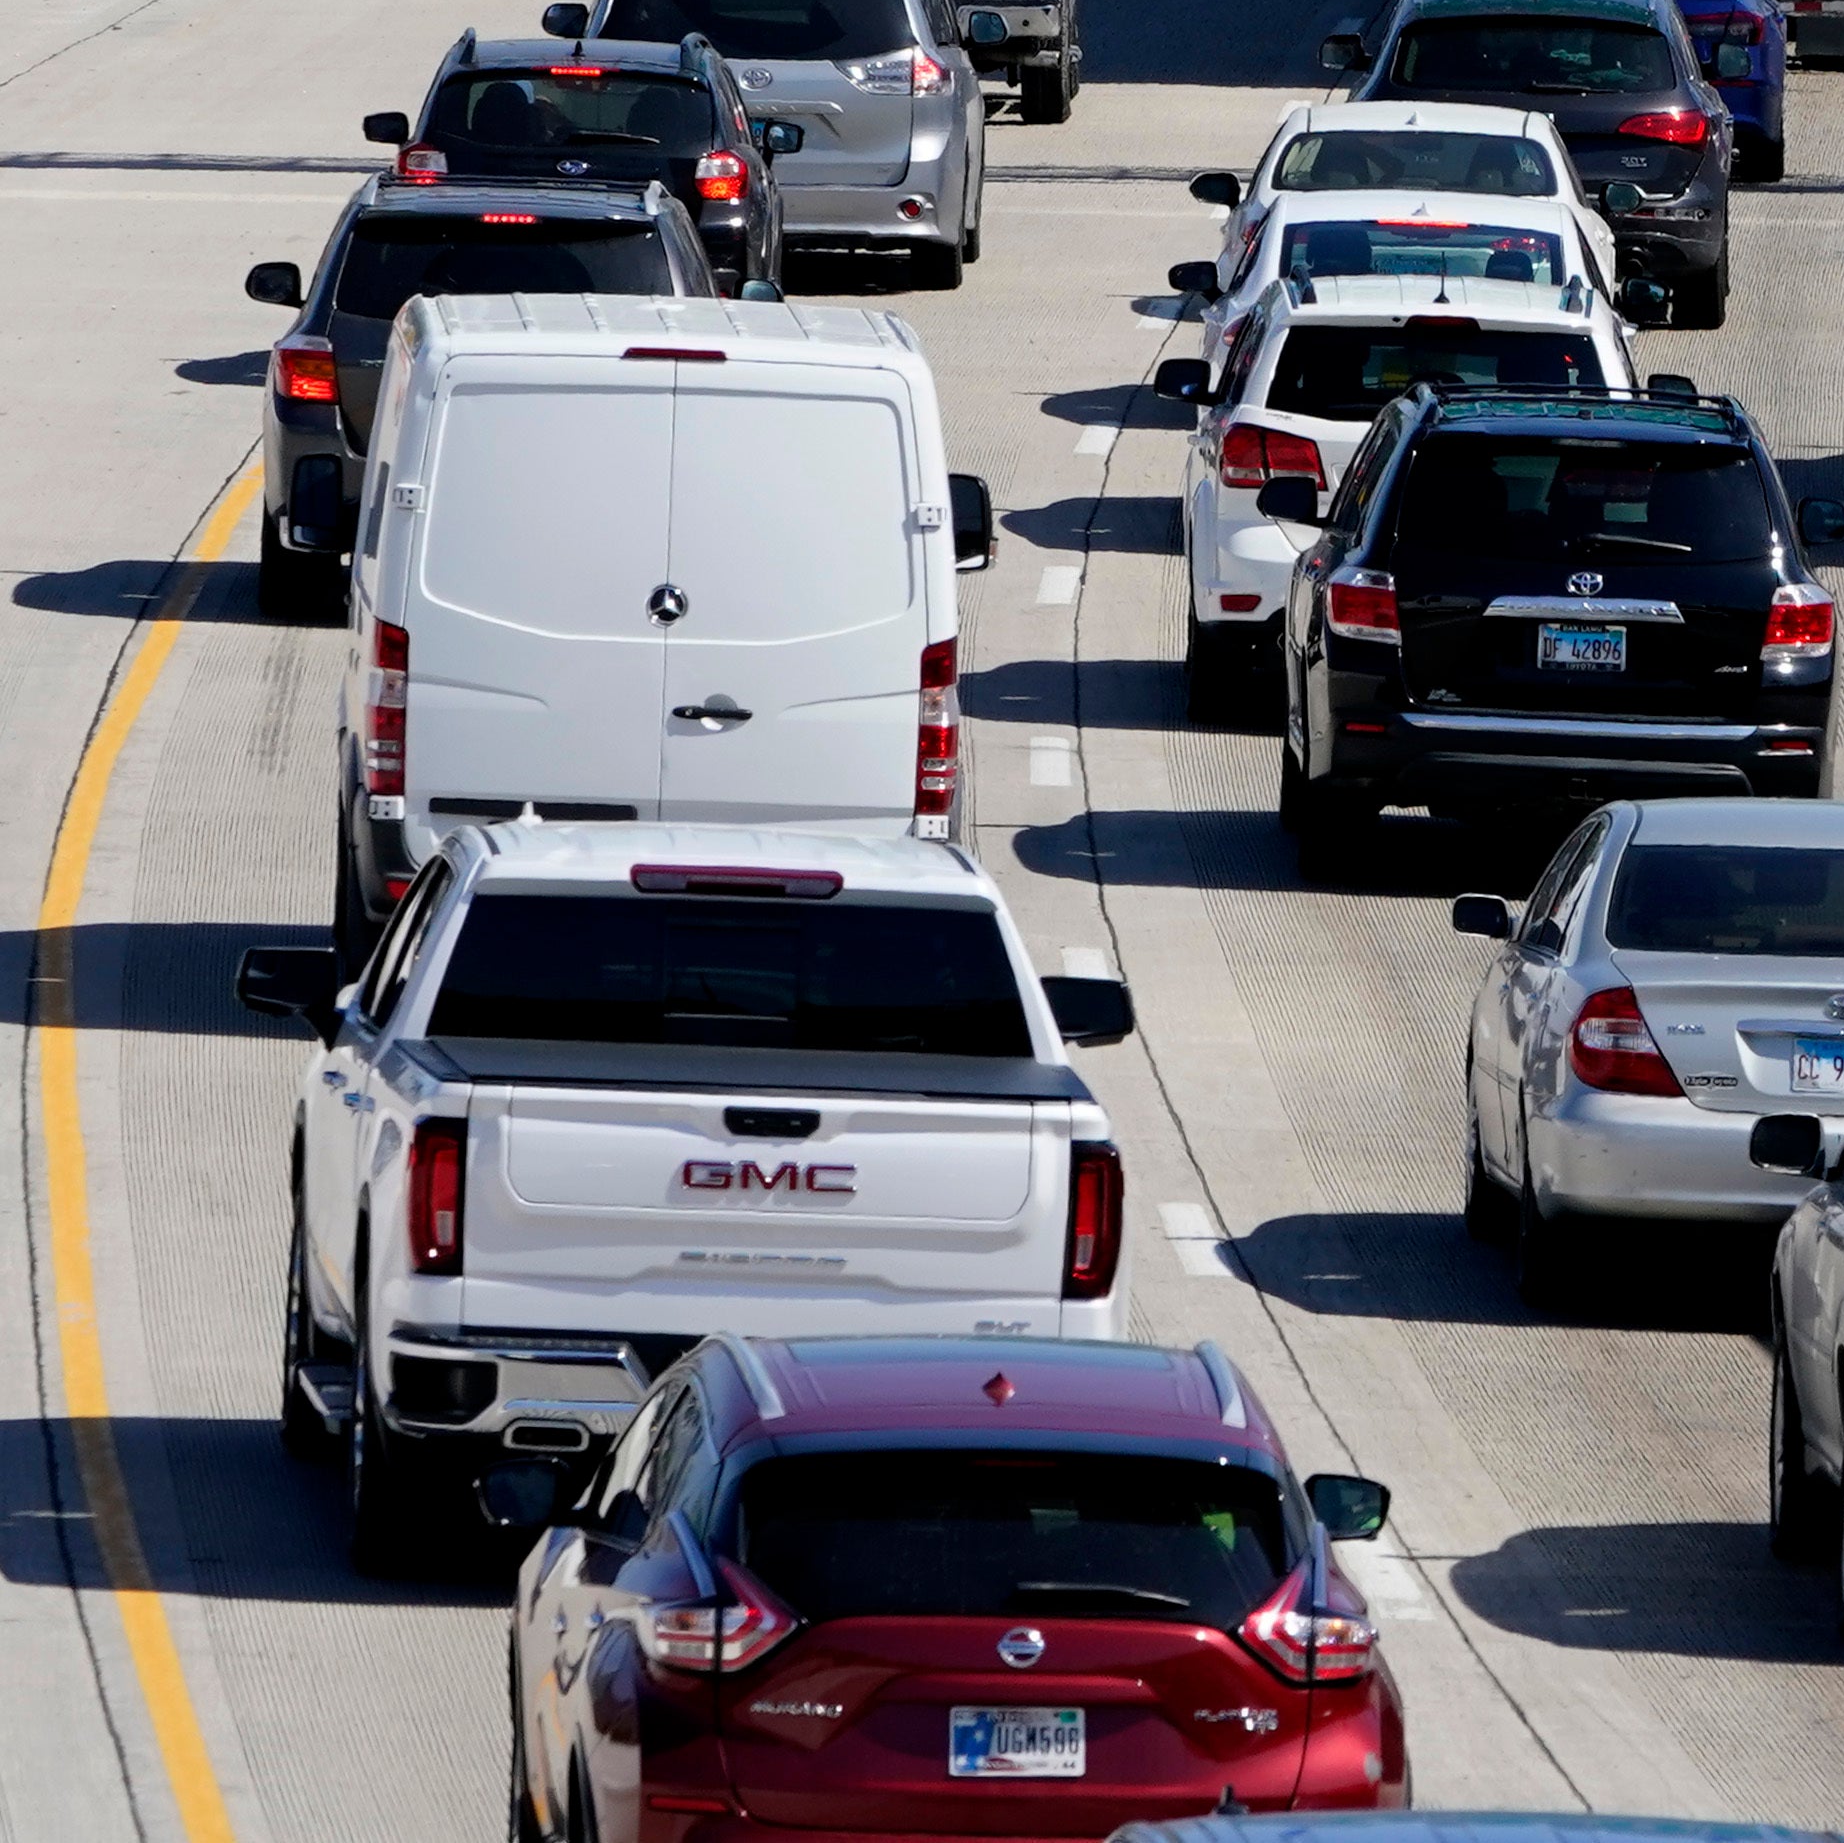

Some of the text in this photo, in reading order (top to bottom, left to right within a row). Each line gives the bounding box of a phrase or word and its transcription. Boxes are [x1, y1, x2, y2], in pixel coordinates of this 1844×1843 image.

[1542, 636, 1622, 662] DF 42896
[1797, 1054, 1820, 1081] CC
[682, 1159, 858, 1193] GMC
